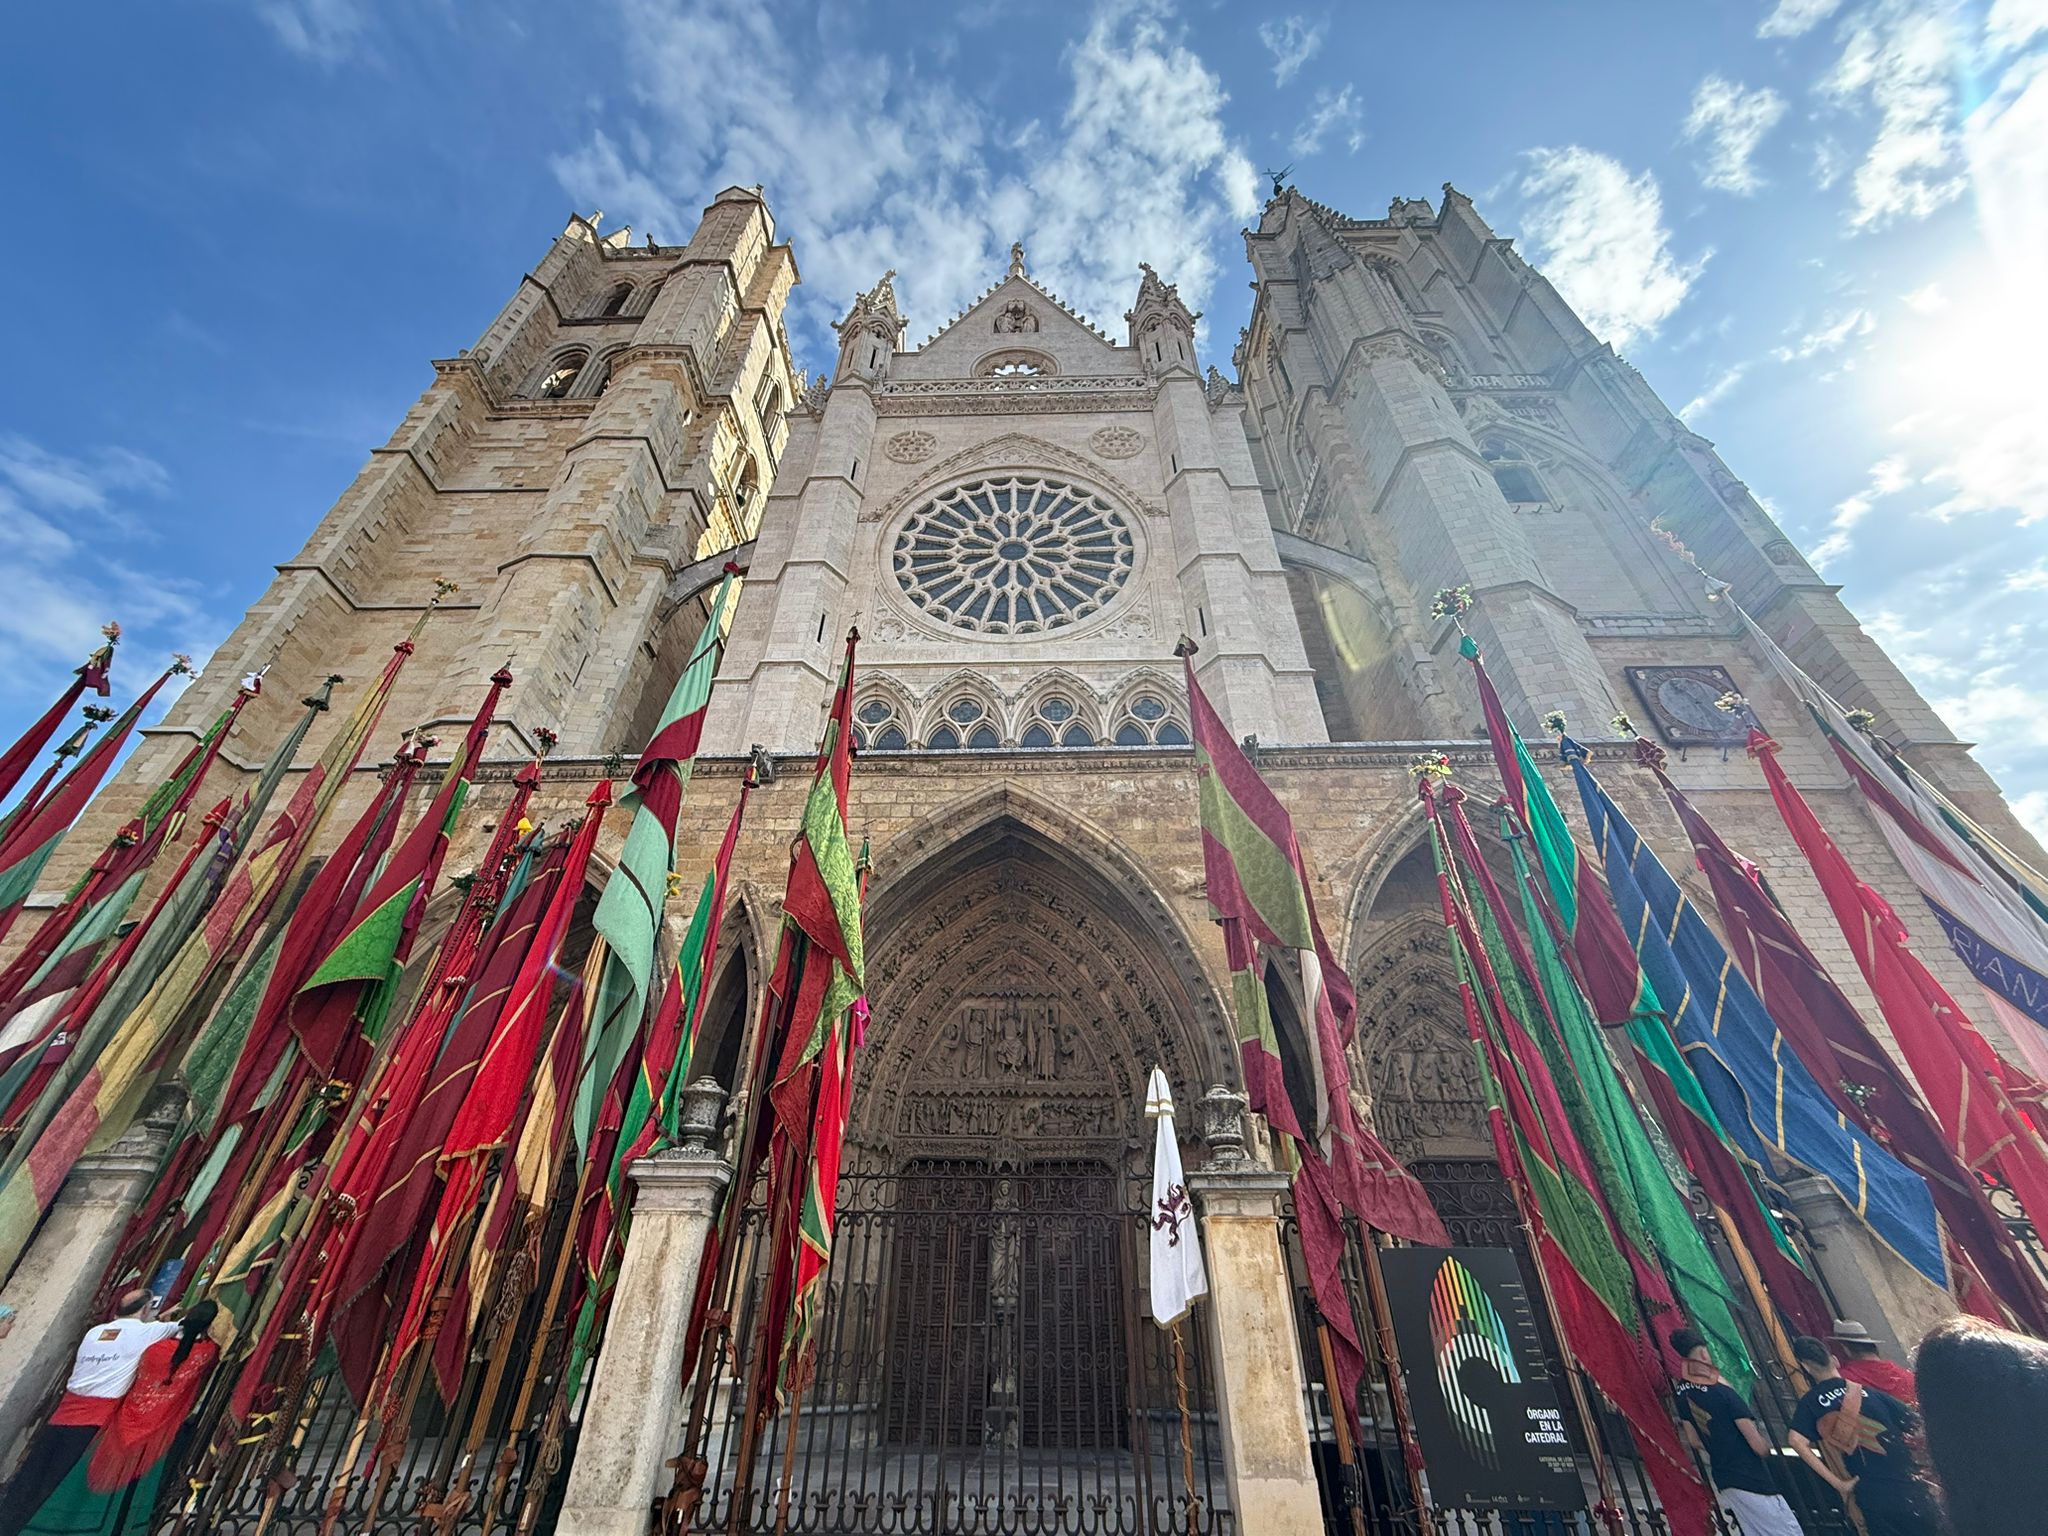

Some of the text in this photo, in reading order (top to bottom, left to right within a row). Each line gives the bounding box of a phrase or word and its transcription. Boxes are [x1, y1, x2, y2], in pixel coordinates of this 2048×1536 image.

[1932, 911, 2048, 1013] RIAN
[1527, 1406, 1560, 1420] ÓRGANO
[1538, 1420, 1564, 1432] EN LA
[1524, 1432, 1568, 1443] CATEDRAL
